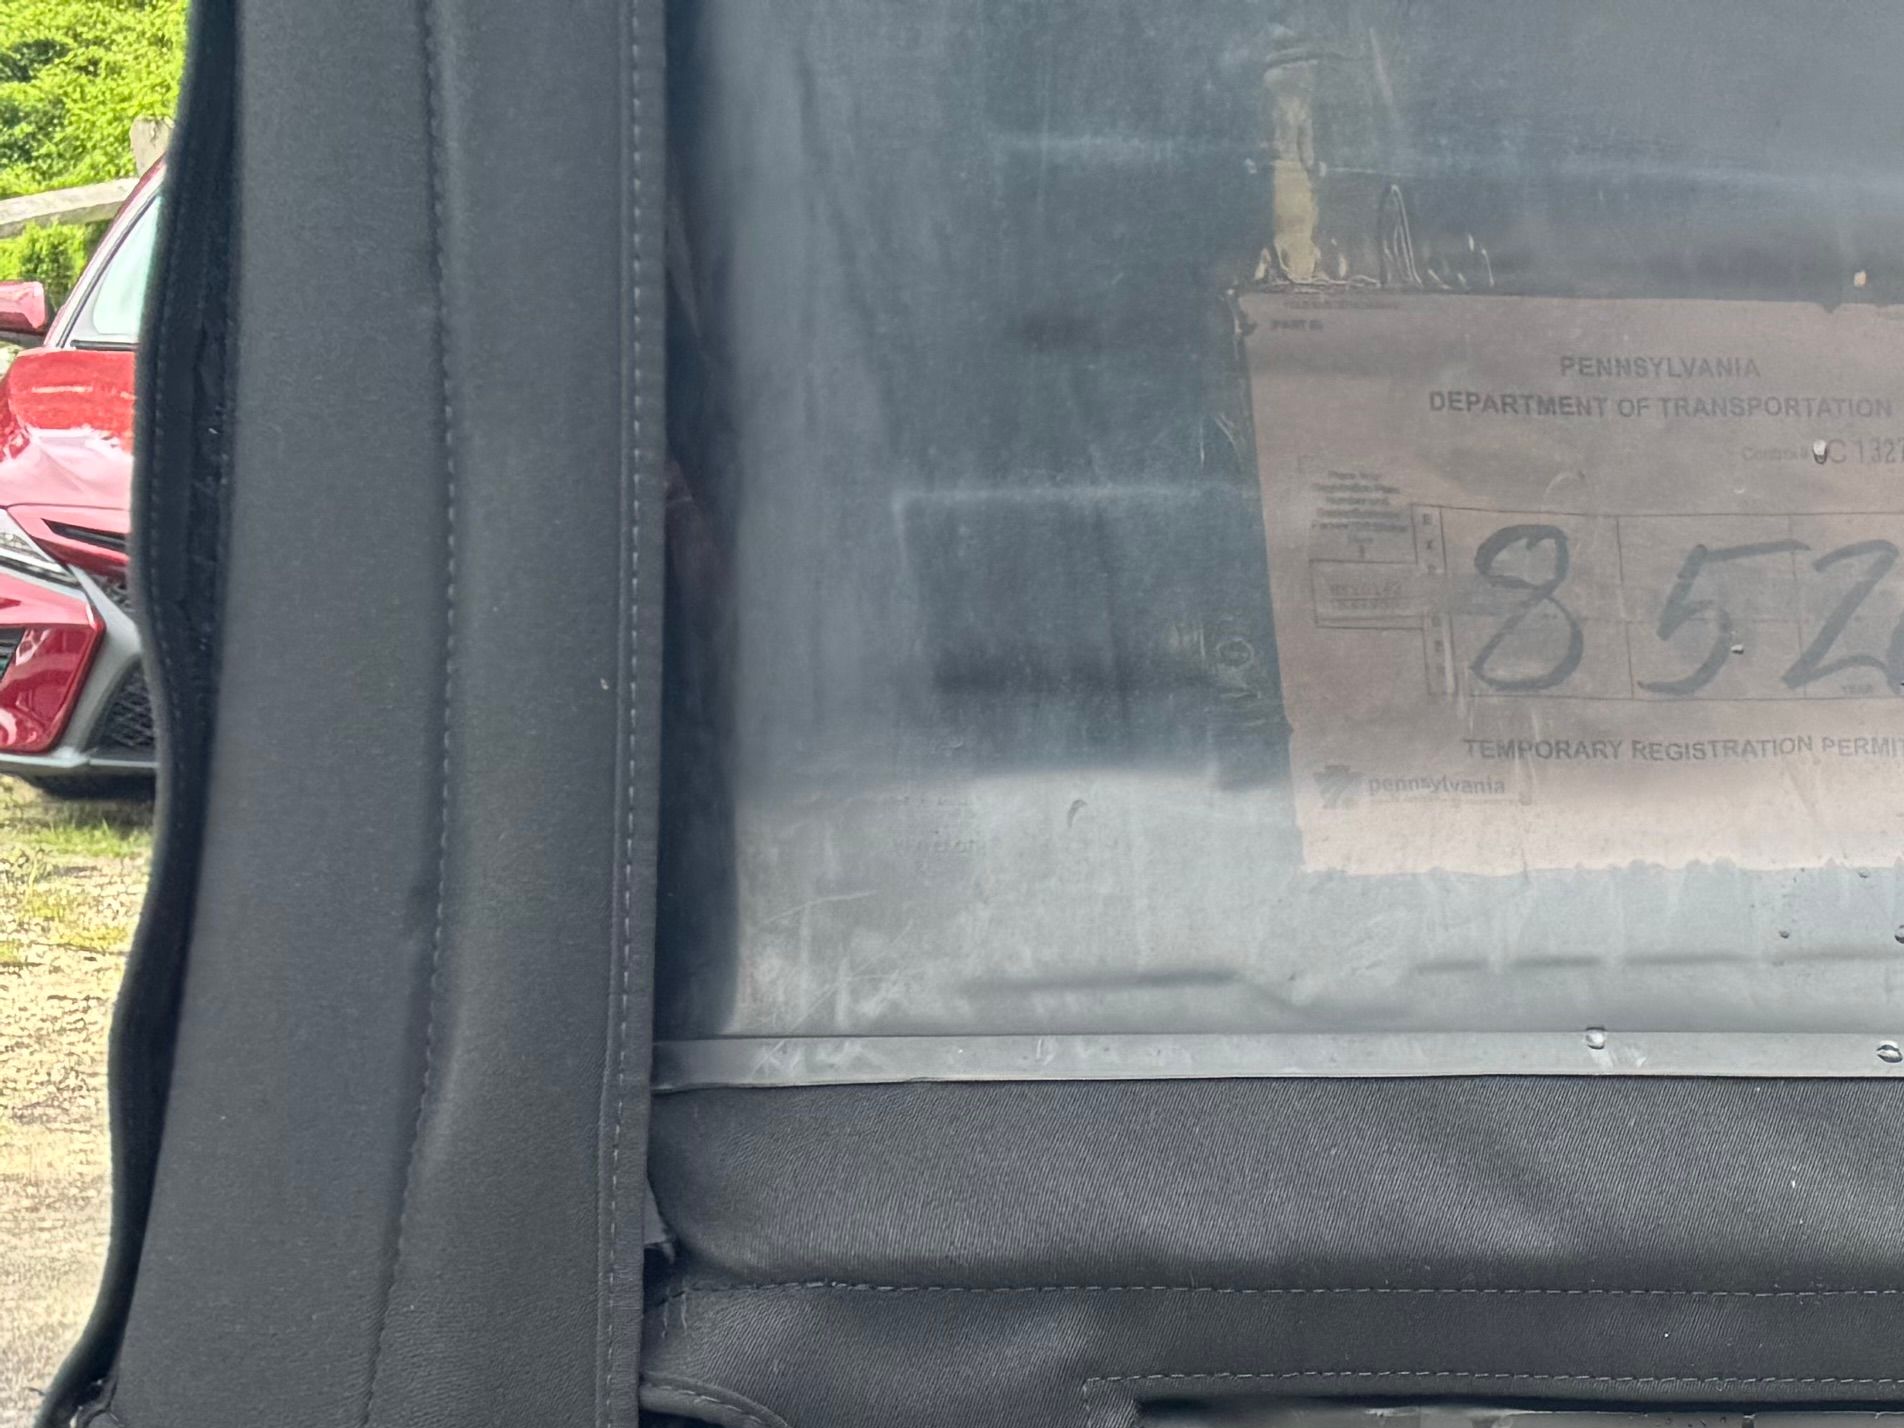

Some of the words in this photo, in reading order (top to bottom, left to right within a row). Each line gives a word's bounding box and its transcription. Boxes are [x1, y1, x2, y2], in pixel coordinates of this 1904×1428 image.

[1560, 354, 1761, 380] PENNSYLVANIA
[1429, 390, 1609, 418] DEPARTMENT
[1618, 396, 1649, 419] OF
[1659, 395, 1894, 420] TRANSPORTATION
[1466, 522, 1585, 692] 8
[1635, 538, 1812, 696] 5
[1462, 736, 1624, 762] TEMPORARY
[1632, 736, 1815, 763] REGISTRATION
[1368, 774, 1506, 797] pennsylvania
